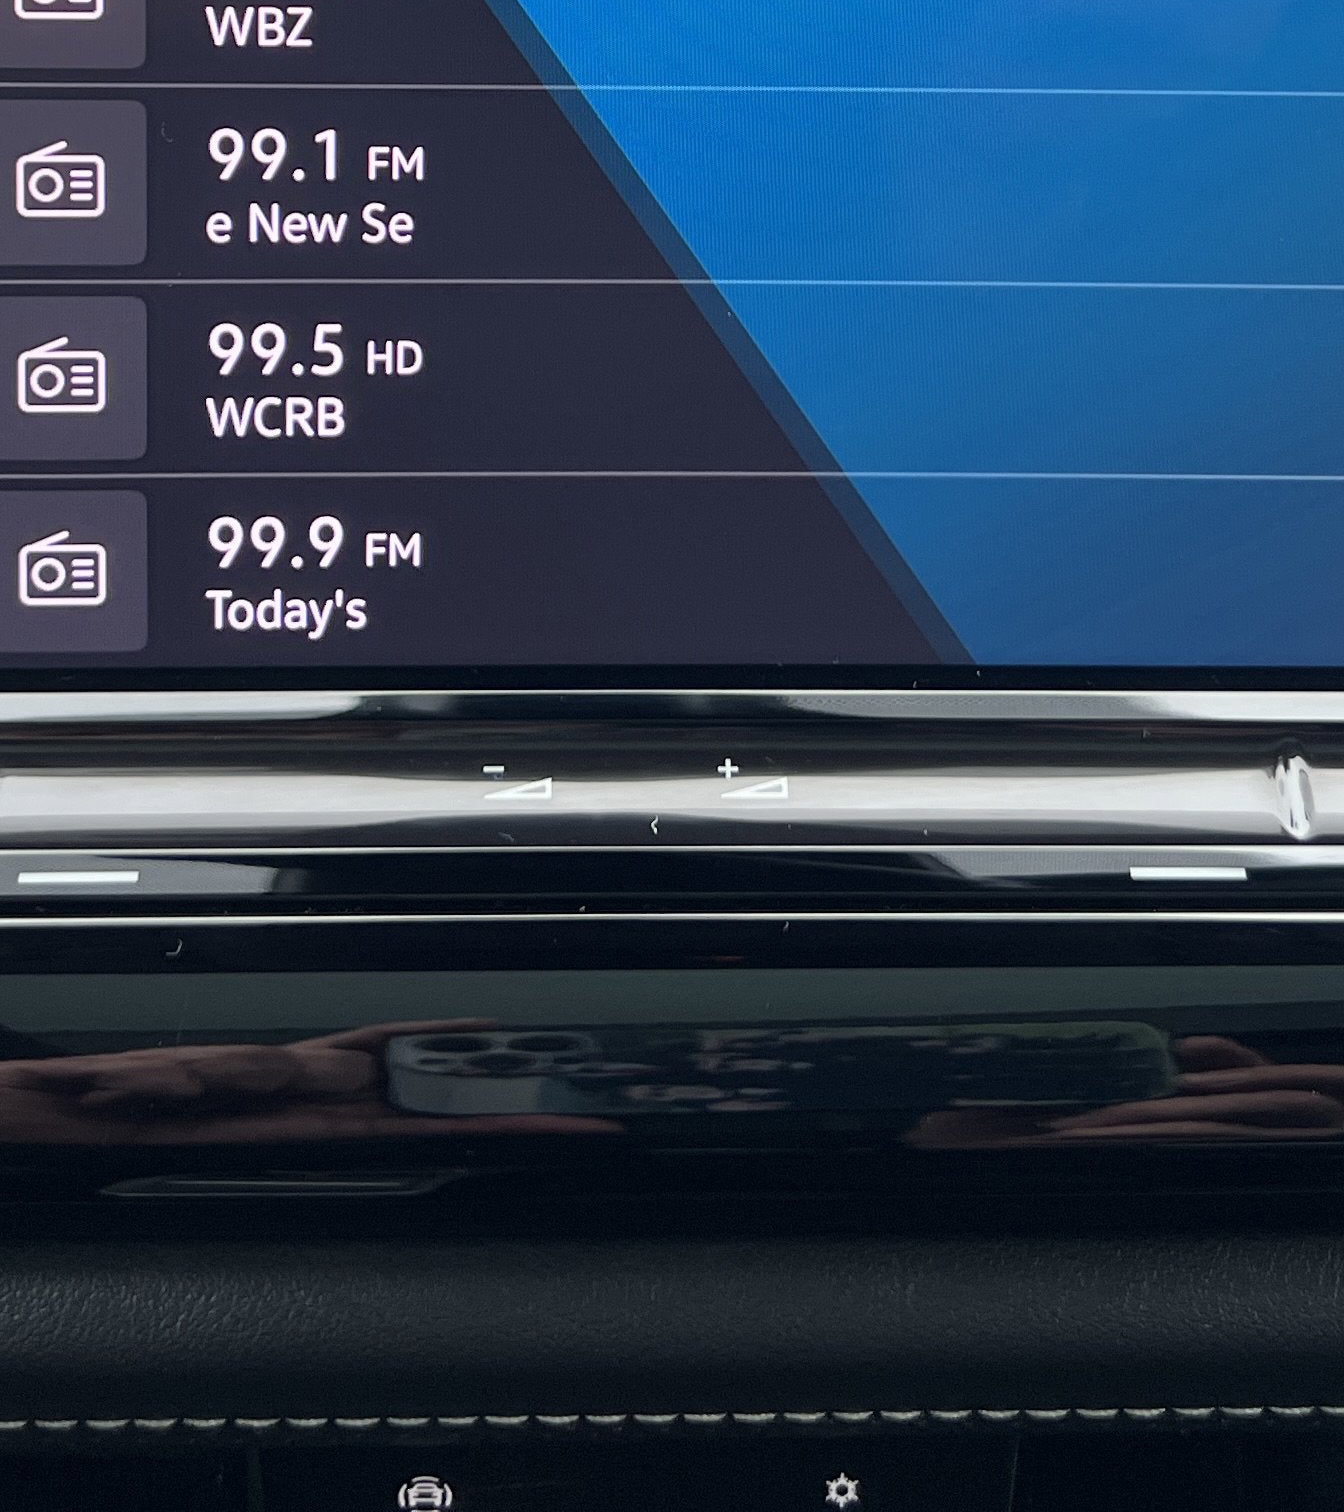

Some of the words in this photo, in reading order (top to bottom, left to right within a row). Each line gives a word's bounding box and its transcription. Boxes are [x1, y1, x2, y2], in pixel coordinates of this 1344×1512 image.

[204, 5, 313, 48] WBZ
[208, 127, 336, 182] 99.1
[367, 146, 424, 181] FM
[205, 212, 233, 244] e
[248, 202, 348, 244] New
[361, 202, 414, 244] Se
[208, 322, 344, 377] 99.5
[367, 339, 423, 376] HD
[205, 396, 345, 438] WCRB
[208, 515, 344, 569] 99.9
[365, 532, 421, 568] FM
[204, 588, 368, 640] Today's
